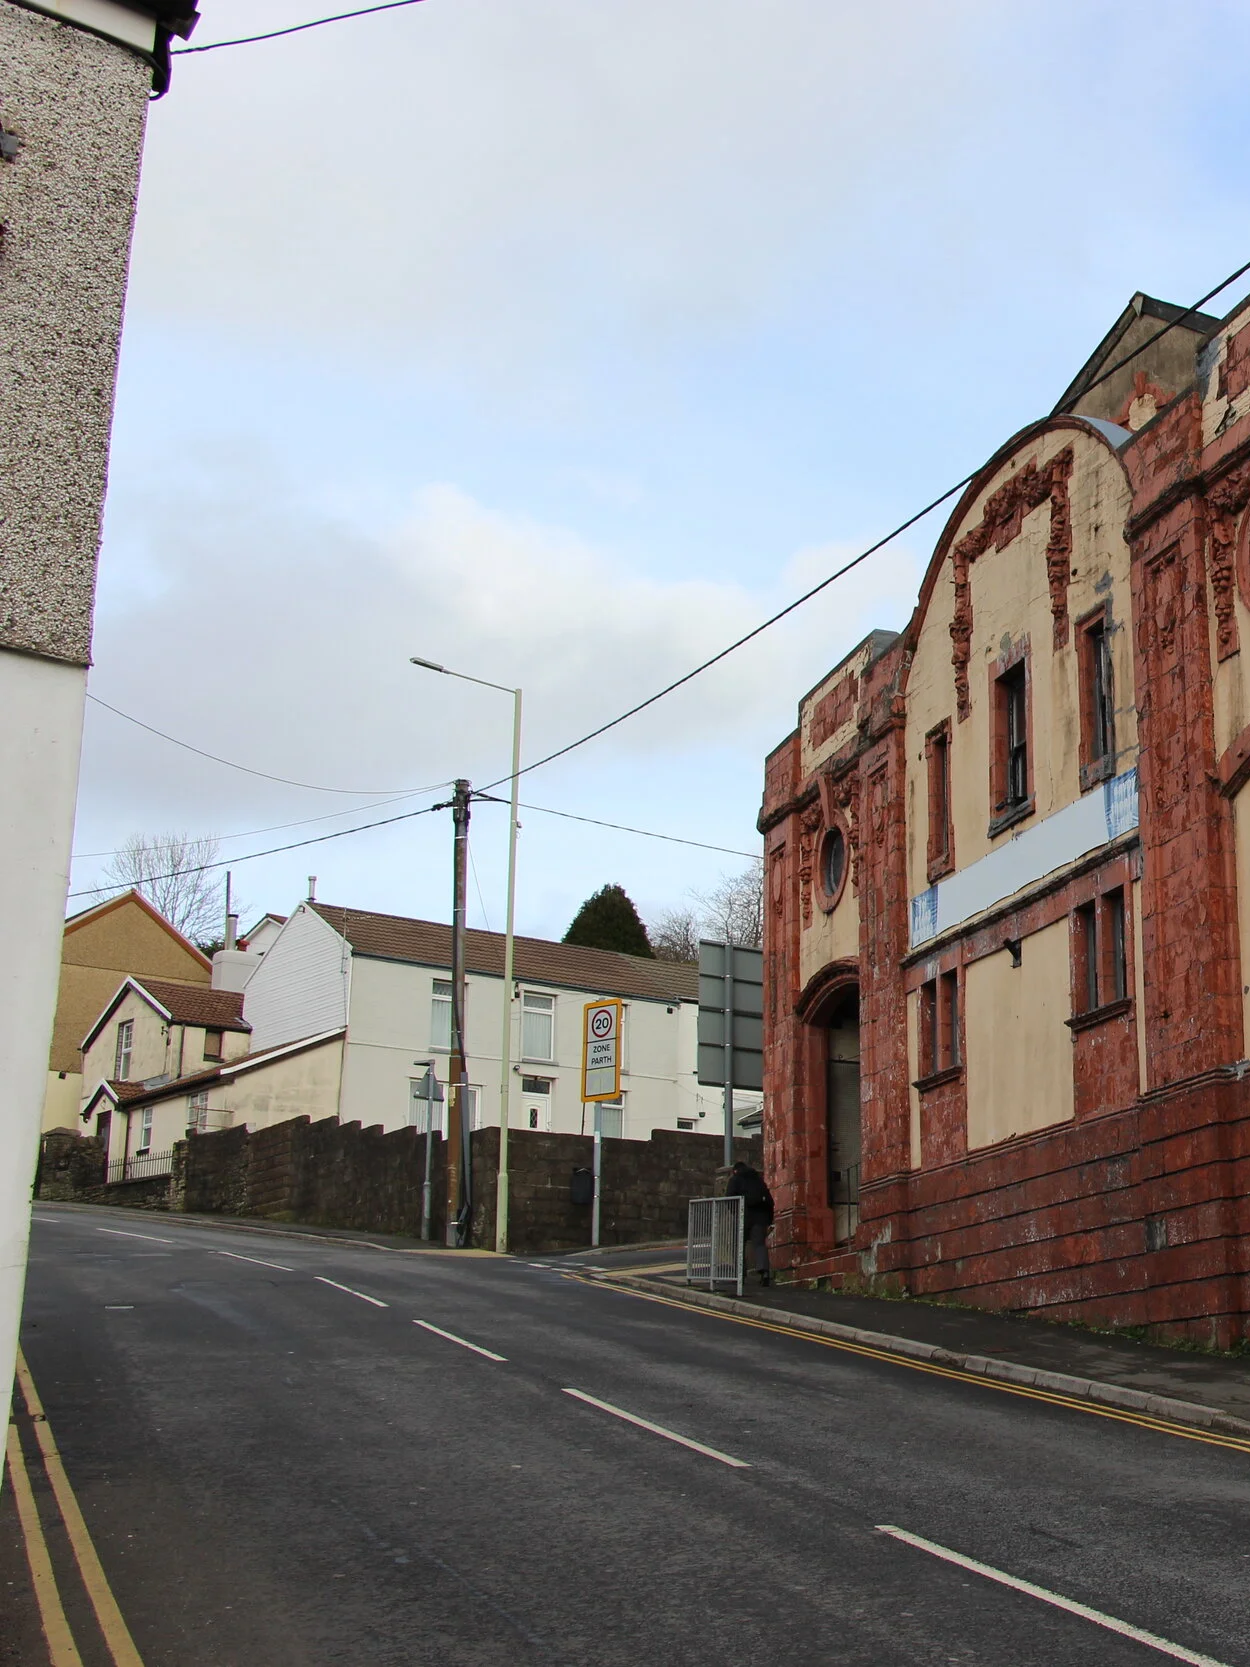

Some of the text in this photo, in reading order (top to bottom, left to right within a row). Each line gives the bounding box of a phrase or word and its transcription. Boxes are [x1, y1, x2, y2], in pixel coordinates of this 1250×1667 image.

[595, 1017, 609, 1030] 20
[593, 1044, 611, 1053] ZONE
[591, 1056, 612, 1065] PARTH
